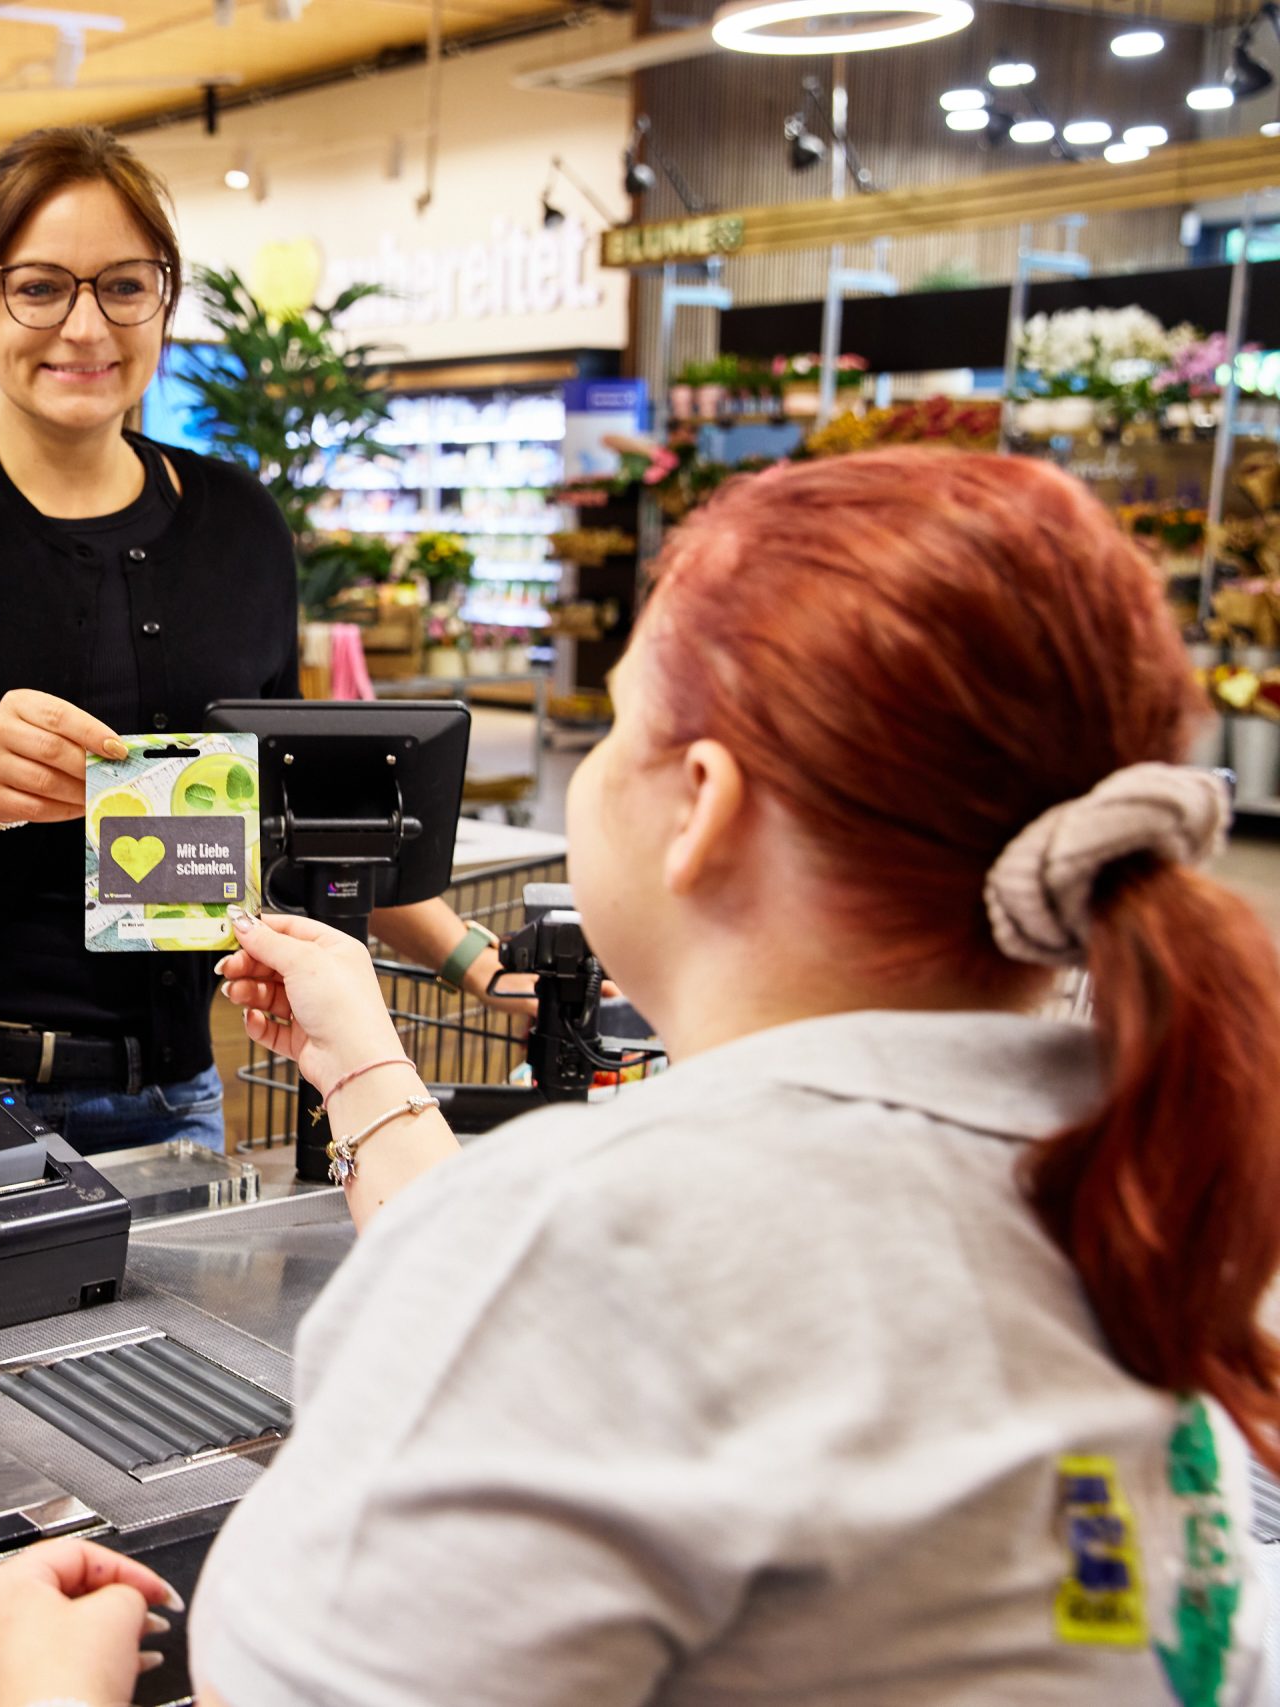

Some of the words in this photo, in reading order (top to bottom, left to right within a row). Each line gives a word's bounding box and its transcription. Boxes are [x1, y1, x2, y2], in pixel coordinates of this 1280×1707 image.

[176, 843, 197, 859] Mit
[199, 843, 230, 859] Liebe
[176, 860, 237, 876] schenken.
